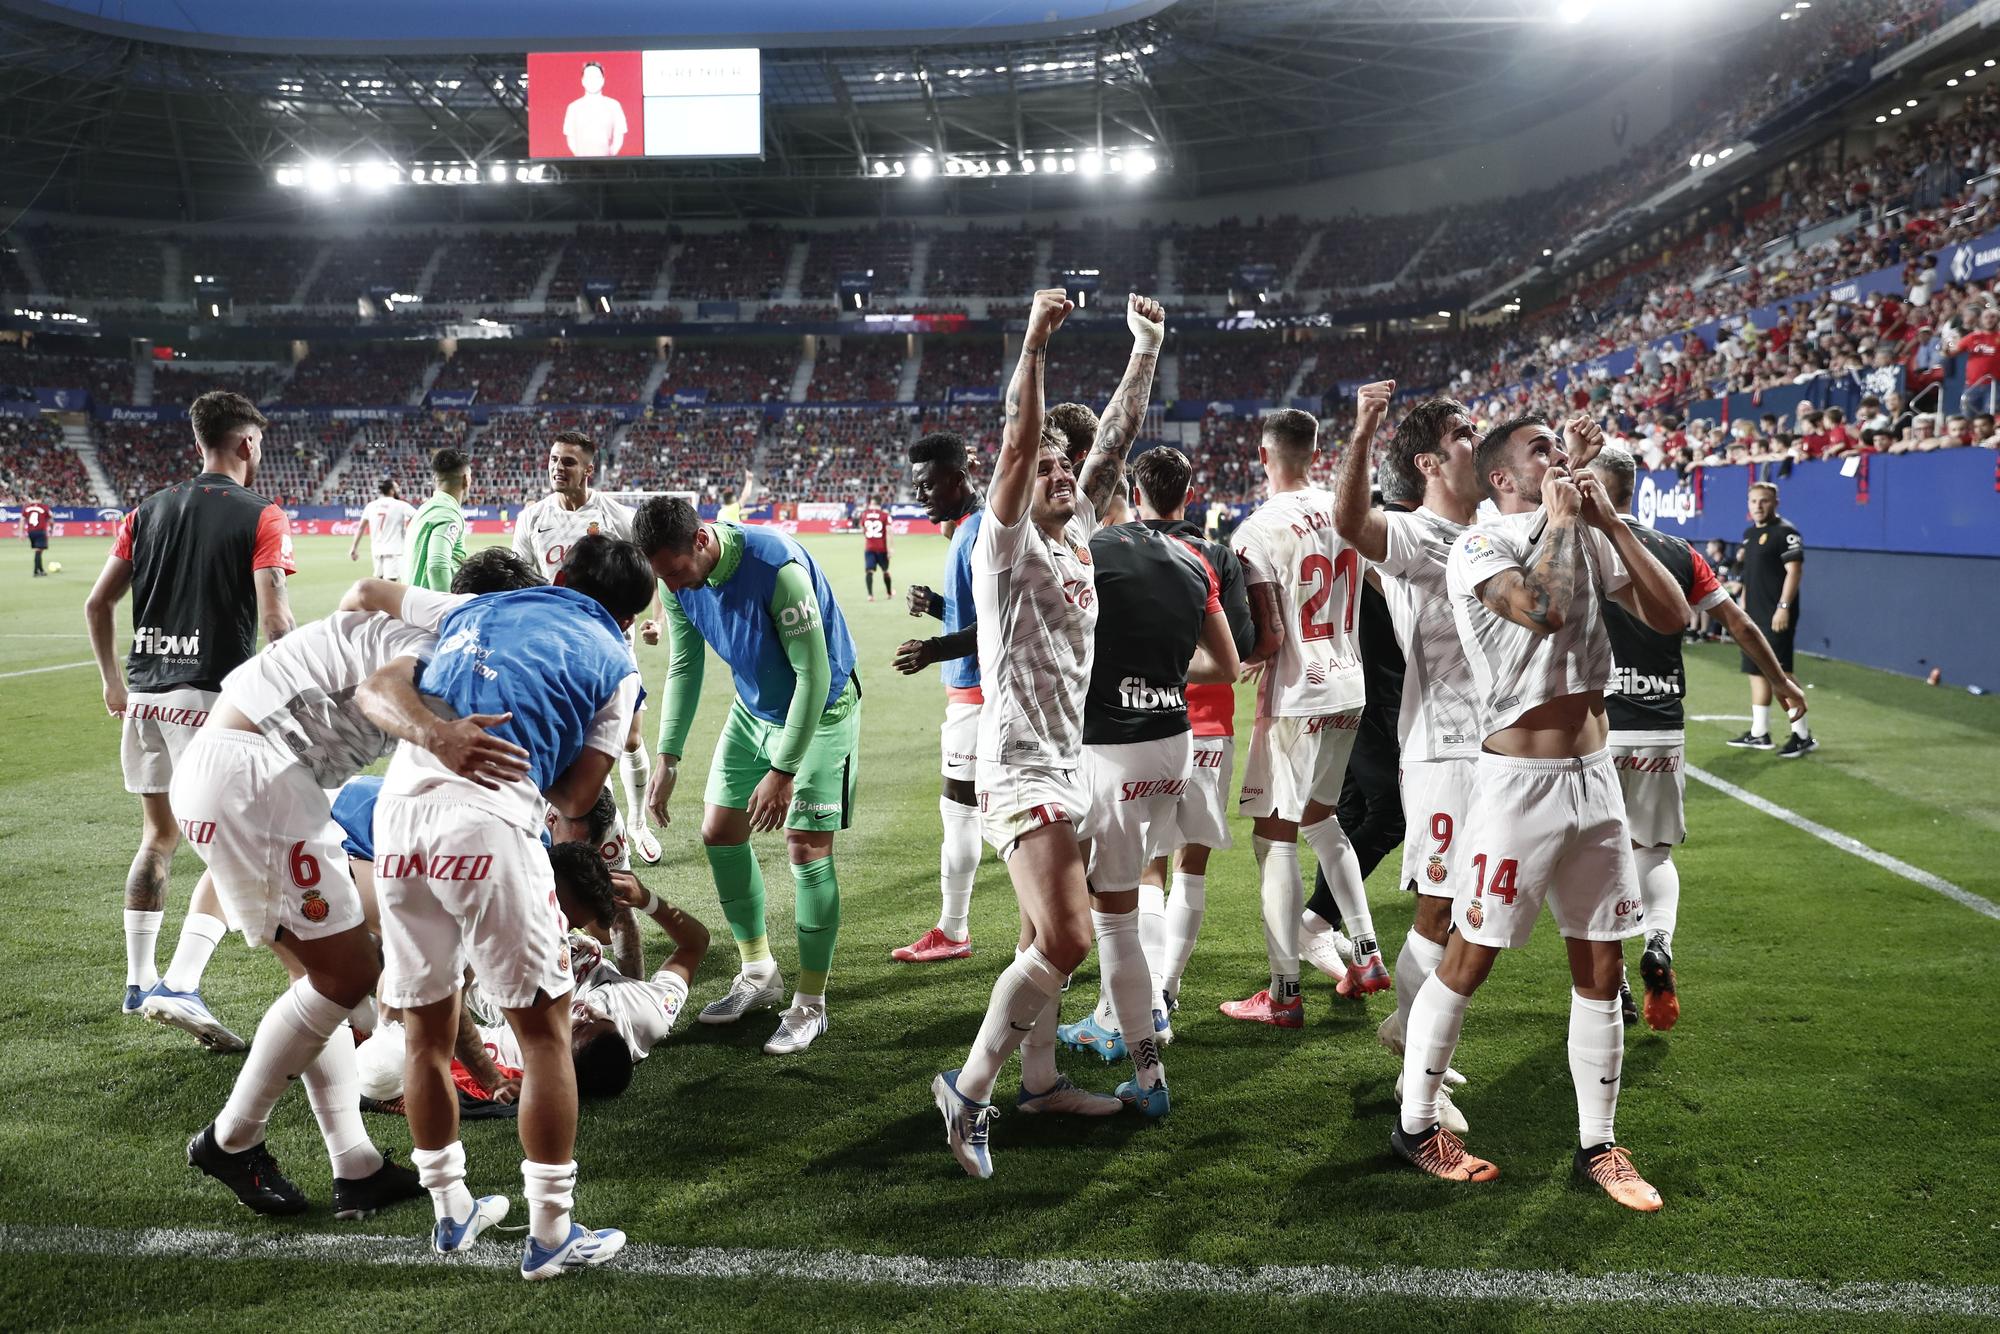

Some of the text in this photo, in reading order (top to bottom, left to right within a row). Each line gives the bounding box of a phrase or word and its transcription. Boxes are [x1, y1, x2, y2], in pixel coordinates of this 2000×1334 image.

[28, 511, 40, 527] 4
[377, 512, 387, 531] 7
[864, 520, 883, 538] 32
[780, 595, 817, 626] OK
[1298, 548, 1358, 643] 21
[134, 626, 200, 656] fibwi
[1119, 677, 1184, 709] fibwi
[1605, 667, 1681, 695] fibwi
[1430, 812, 1454, 855] 9
[288, 840, 322, 889] 6
[1471, 852, 1519, 905] 14
